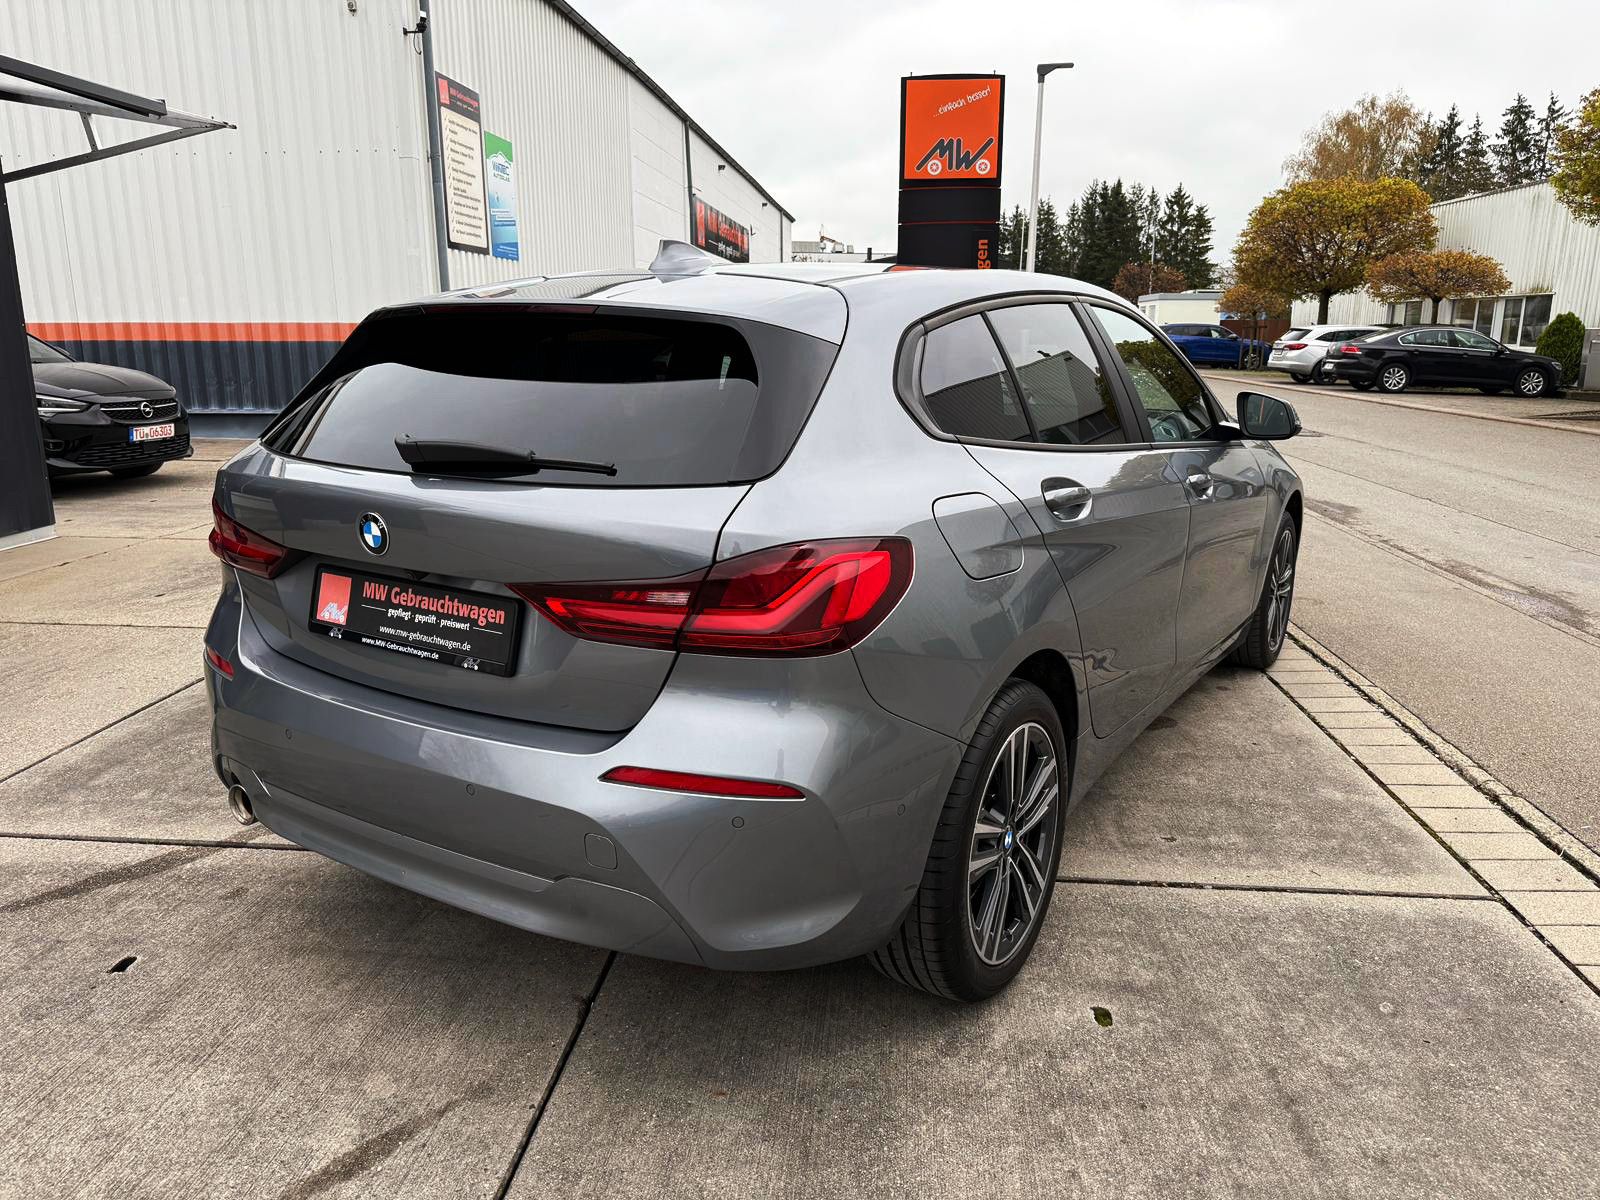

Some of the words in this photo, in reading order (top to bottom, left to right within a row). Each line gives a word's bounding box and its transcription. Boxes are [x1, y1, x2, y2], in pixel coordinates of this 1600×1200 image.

[915, 137, 994, 173] MW
[363, 581, 388, 601] MW
[391, 587, 505, 627] Gebrauchtwagen
[387, 608, 411, 620] gepflegt
[414, 613, 437, 625] geprüft
[439, 618, 471, 631] preiswert
[361, 636, 439, 660] www.MW-Gebrauchtwagen.de
[379, 625, 471, 651] www.mw-gebrauchtwagen.de
